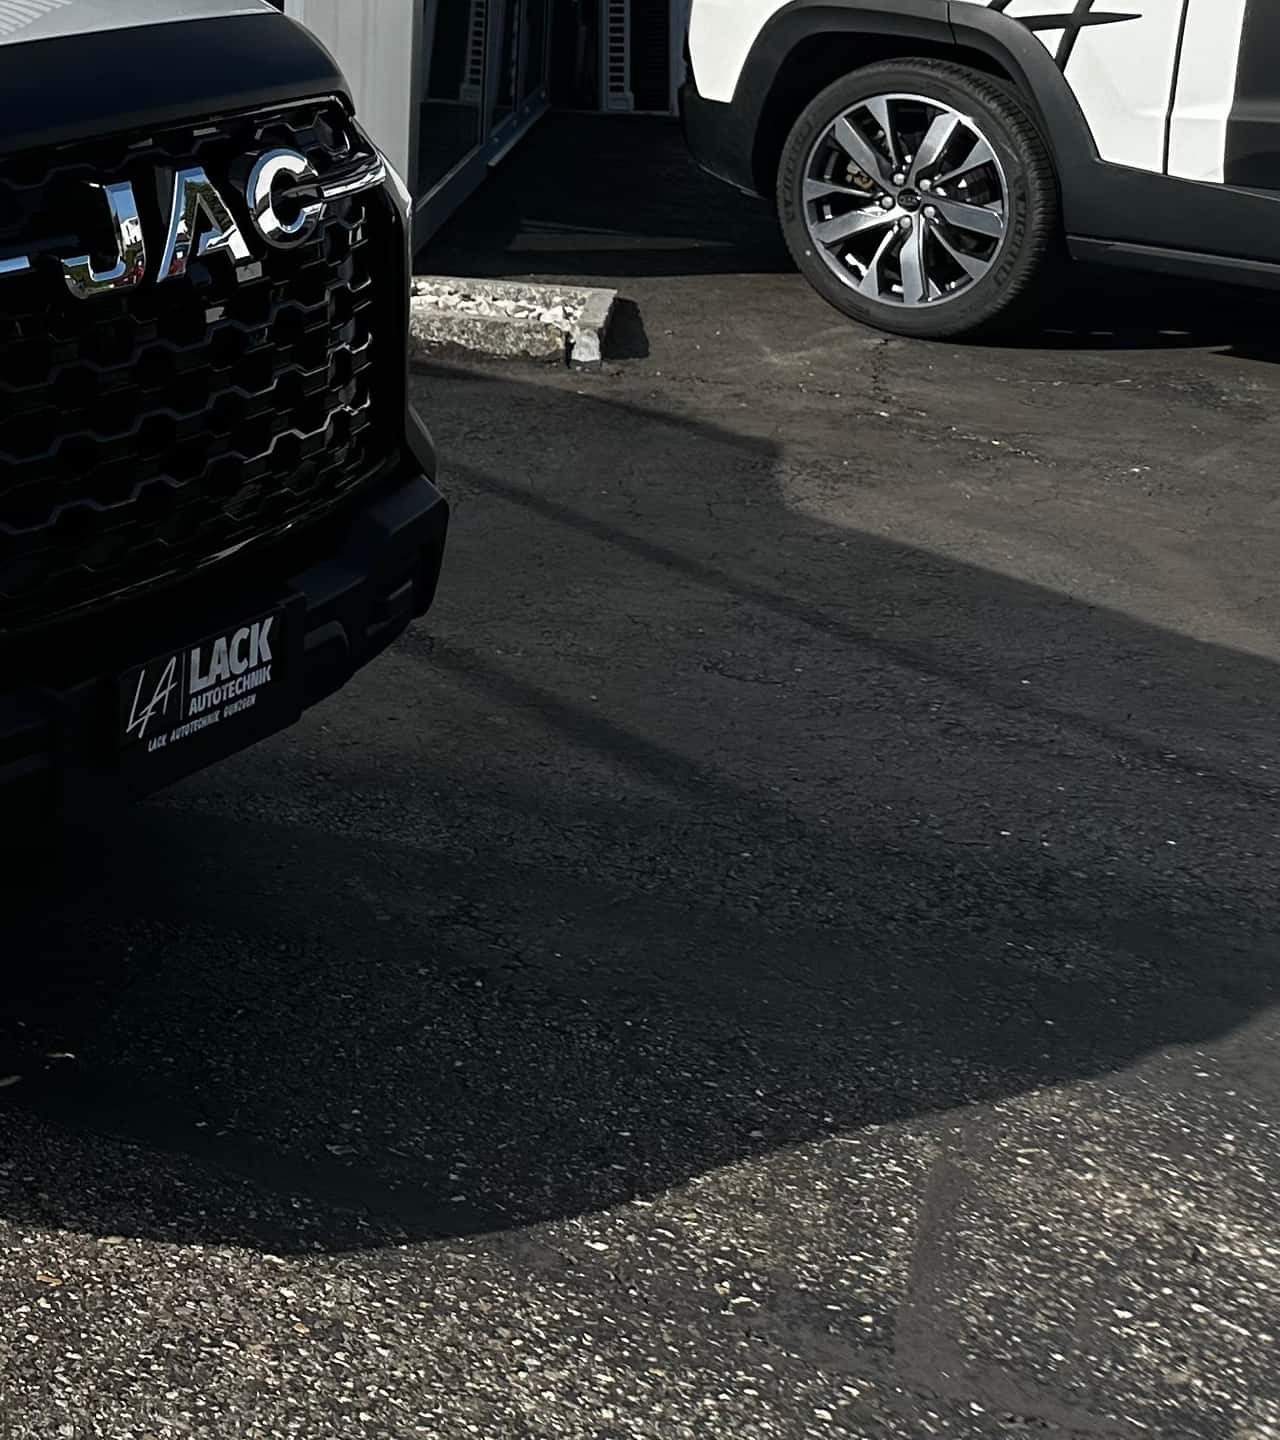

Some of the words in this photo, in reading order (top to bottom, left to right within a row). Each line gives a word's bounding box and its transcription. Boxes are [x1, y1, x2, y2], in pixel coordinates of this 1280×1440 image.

[60, 148, 324, 300] JAC
[188, 664, 272, 716] AUTOTECHNIK
[189, 615, 274, 694] LACK
[125, 655, 179, 739] LA
